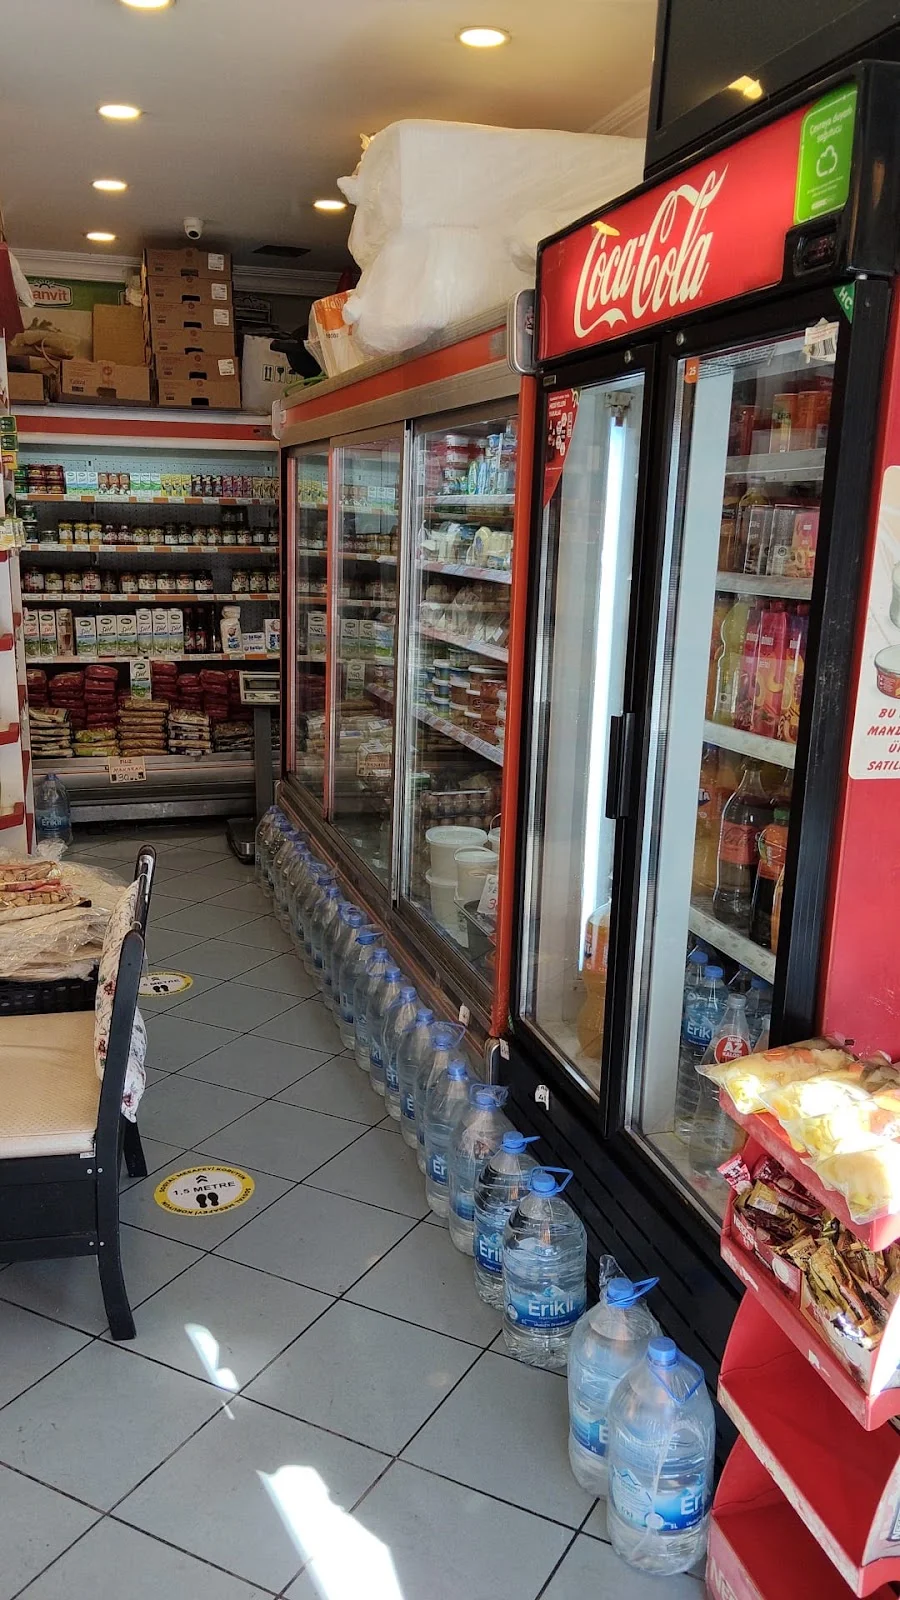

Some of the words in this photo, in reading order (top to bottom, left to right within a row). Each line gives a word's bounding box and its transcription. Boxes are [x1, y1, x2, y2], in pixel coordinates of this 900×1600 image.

[573, 163, 729, 338] Coca-Cola
[32, 289, 68, 302] anvit
[838, 287, 853, 310] HC
[878, 708, 896, 719] BU
[723, 1041, 743, 1053] AZ
[193, 1181, 236, 1192] METRE
[528, 1294, 576, 1317] Erikli
